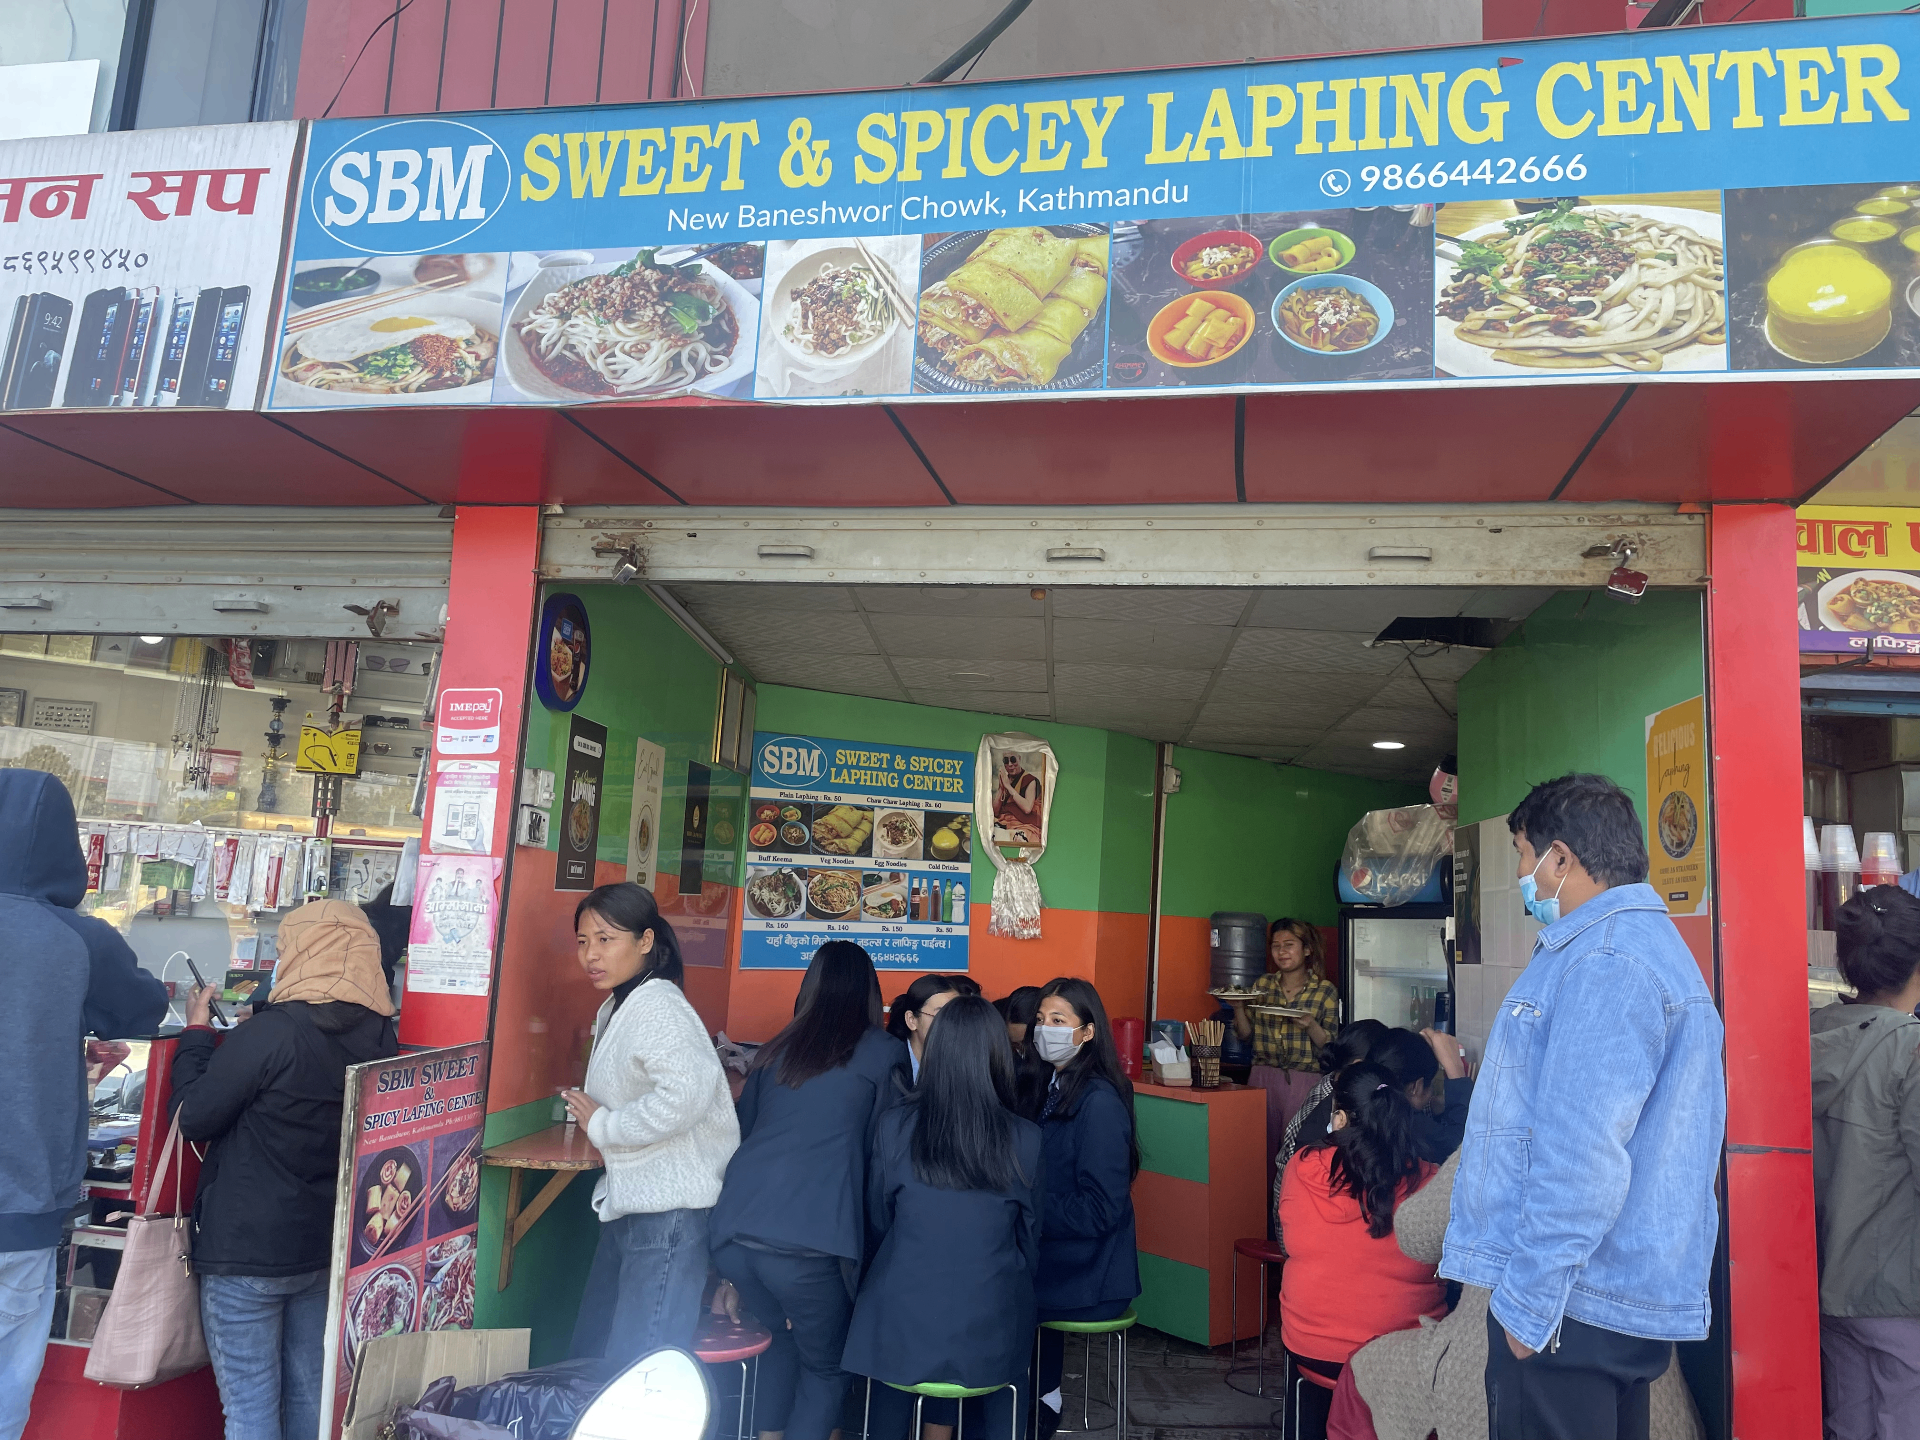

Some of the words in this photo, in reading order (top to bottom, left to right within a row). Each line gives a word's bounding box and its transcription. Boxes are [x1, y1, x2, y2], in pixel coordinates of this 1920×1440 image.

[521, 119, 759, 202] SWEET
[780, 117, 832, 189] &
[854, 95, 1124, 186] SPICEY
[1145, 67, 1509, 165] LAPHING
[1535, 43, 1909, 140] CENTER
[325, 144, 493, 227] SBM
[1360, 153, 1588, 194] 9866442666
[127, 168, 271, 221] सप
[667, 208, 730, 232] New
[738, 203, 893, 229] Baneshwor
[900, 193, 1007, 222] Chowk,
[1017, 184, 1190, 213] Kathmandu
[44, 312, 63, 328] 9:42
[1653, 721, 1695, 758] DELICIOUS
[763, 745, 820, 777] SBM
[836, 749, 890, 768] SWEET
[894, 754, 906, 770] &
[910, 755, 963, 775] SPICEY
[779, 791, 794, 799] Plain
[830, 767, 899, 788] LAPHING
[903, 774, 964, 793] CENTER
[820, 857, 831, 865] Veg
[832, 858, 854, 866] Noodles
[874, 860, 884, 868] Egg
[885, 860, 907, 868] Noodles
[377, 1067, 417, 1093] SBM
[420, 1055, 478, 1086] SWEET
[424, 1086, 434, 1101] &
[363, 1110, 402, 1132] SPICY
[401, 1099, 444, 1124] LAFING
